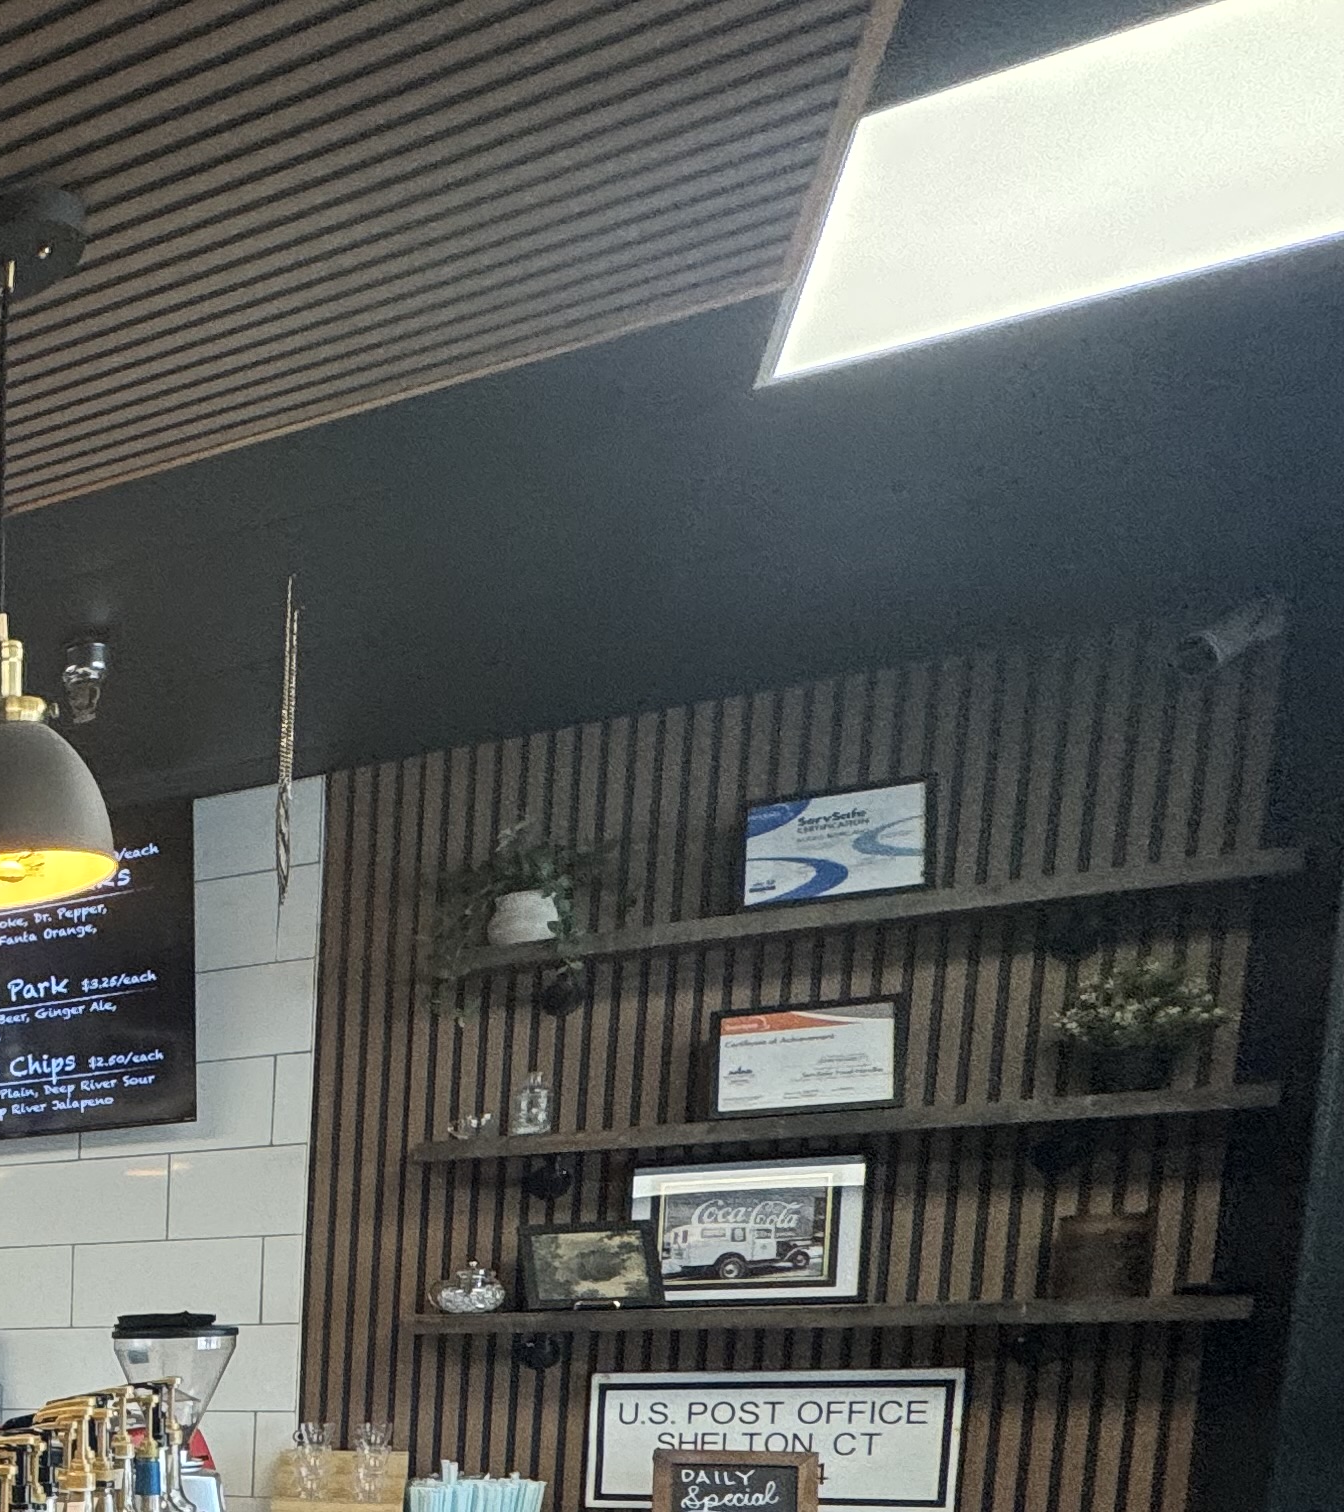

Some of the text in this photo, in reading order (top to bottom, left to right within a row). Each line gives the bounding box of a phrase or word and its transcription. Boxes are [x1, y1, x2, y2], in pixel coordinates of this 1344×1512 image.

[115, 843, 159, 861] /each
[34, 912, 52, 923] Dr.
[56, 904, 107, 923] Pepper,
[43, 923, 97, 940] Orange,
[7, 976, 69, 1001] Park
[35, 1005, 85, 1020] Ginger
[90, 1001, 117, 1013] Ale,
[10, 1055, 77, 1085] Chips
[0, 1088, 38, 1100] Plain,
[44, 1083, 75, 1098] Deep
[81, 1078, 116, 1091] River
[122, 1074, 155, 1087] Sour
[12, 1102, 47, 1114] River
[618, 1400, 928, 1425] U.S. POST OFFICE
[657, 1432, 883, 1456] SHELTON CT
[681, 1470, 756, 1485] DAILY
